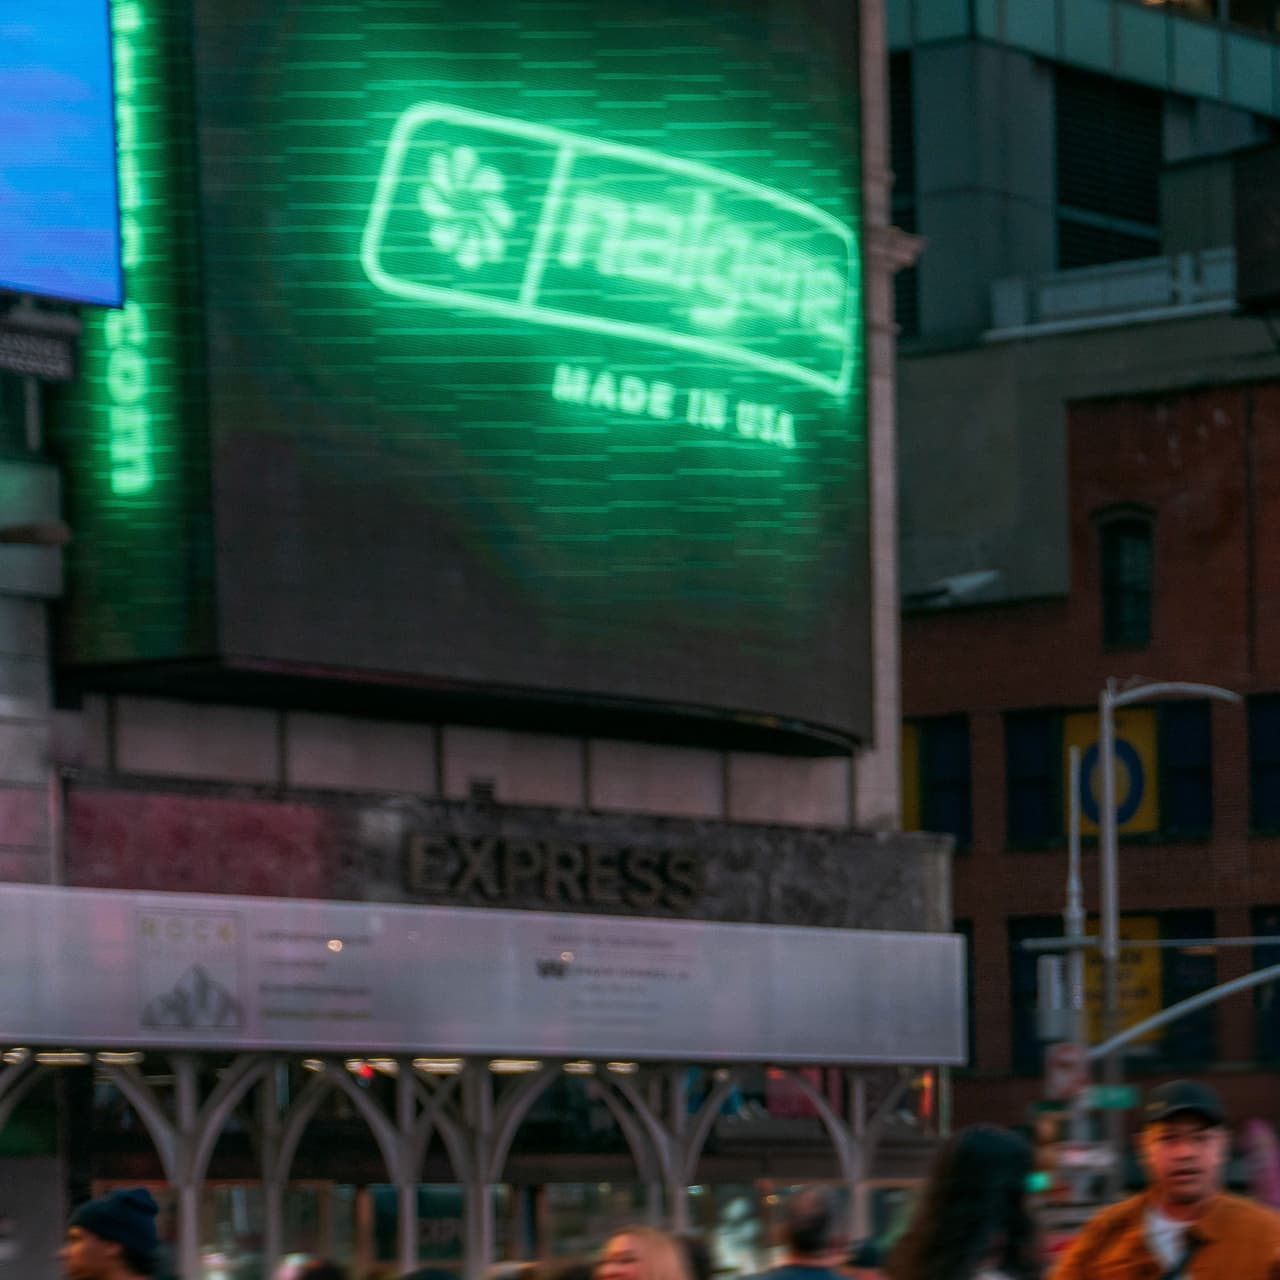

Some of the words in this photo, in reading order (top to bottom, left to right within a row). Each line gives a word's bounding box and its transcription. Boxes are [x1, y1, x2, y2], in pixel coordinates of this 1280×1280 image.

[552, 364, 675, 420] MADE
[686, 388, 727, 432] IN
[405, 830, 700, 910] EXPRESS
